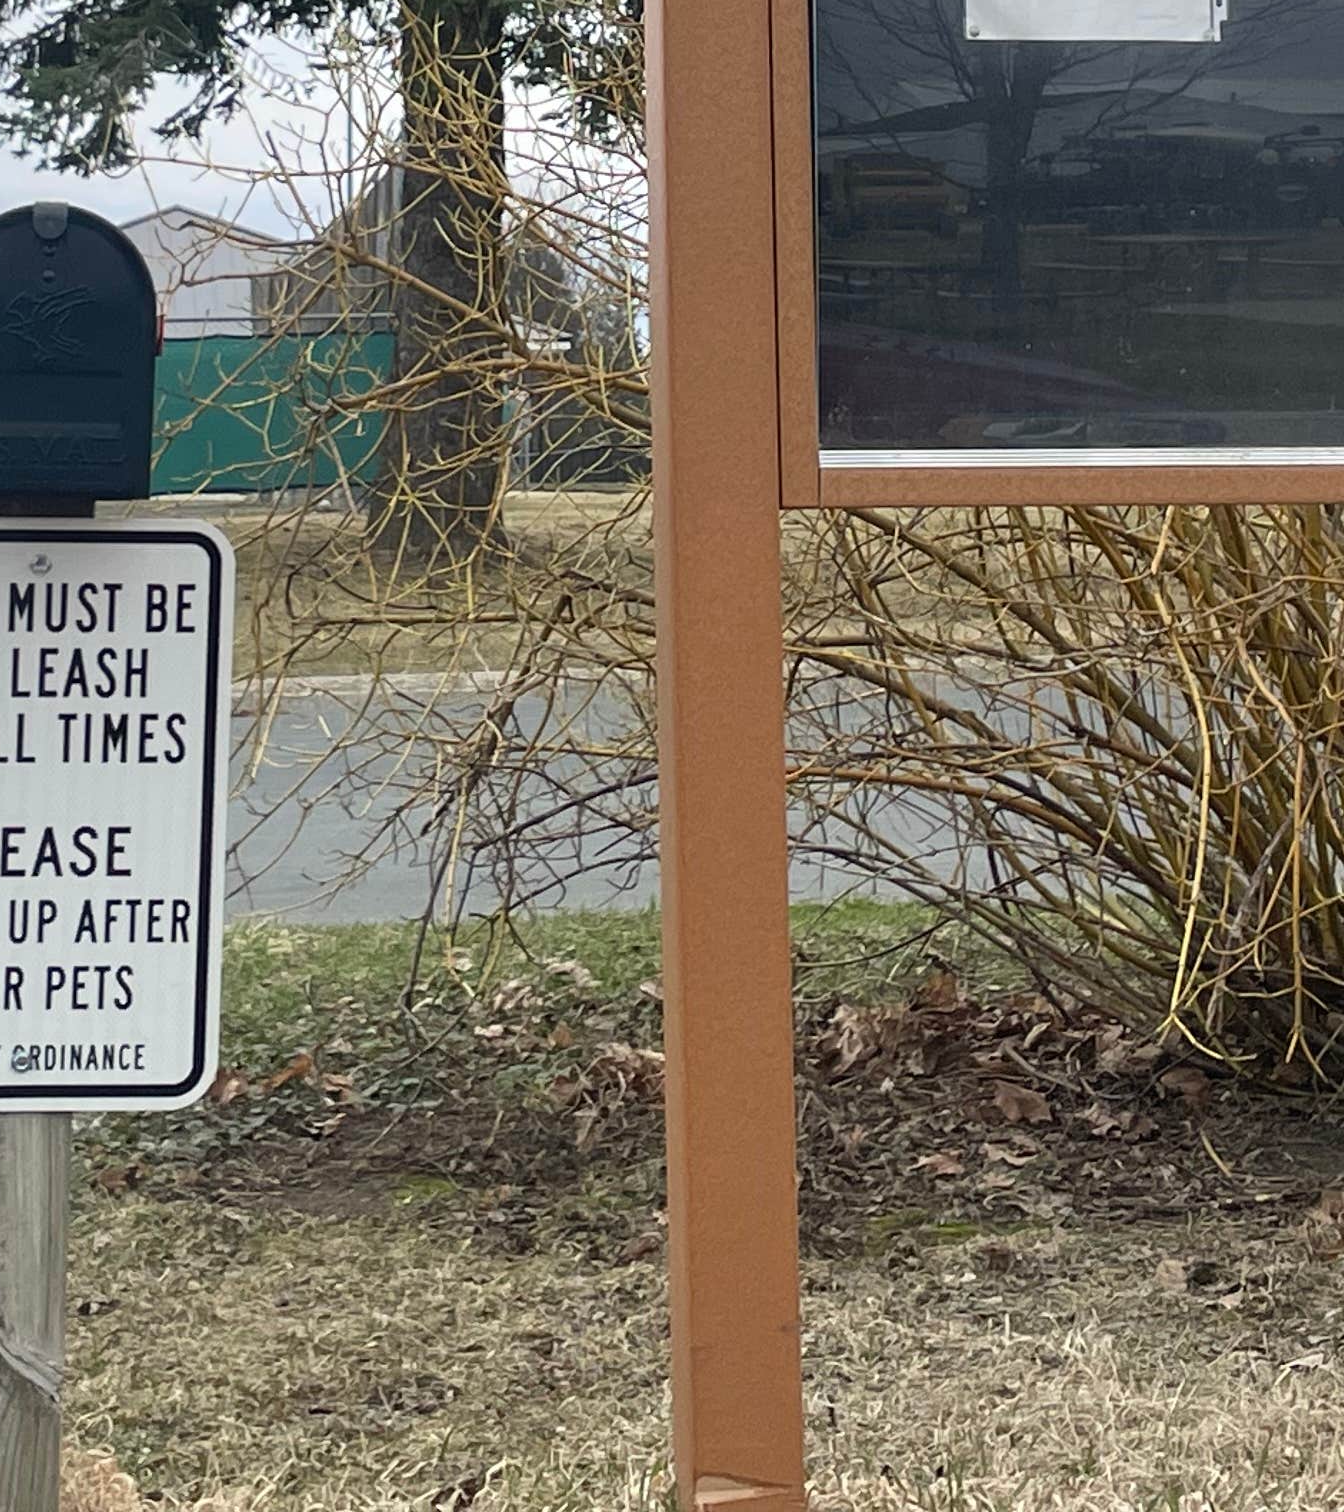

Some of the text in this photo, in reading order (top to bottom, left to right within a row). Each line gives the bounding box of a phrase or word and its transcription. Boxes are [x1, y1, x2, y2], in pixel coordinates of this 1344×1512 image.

[8, 582, 123, 633] MUST
[146, 583, 197, 634] BE
[11, 648, 149, 698] LEASH
[58, 713, 187, 764] TIMES
[9, 899, 58, 944] UP
[75, 899, 191, 943] AFTER
[46, 966, 134, 1010] PETS
